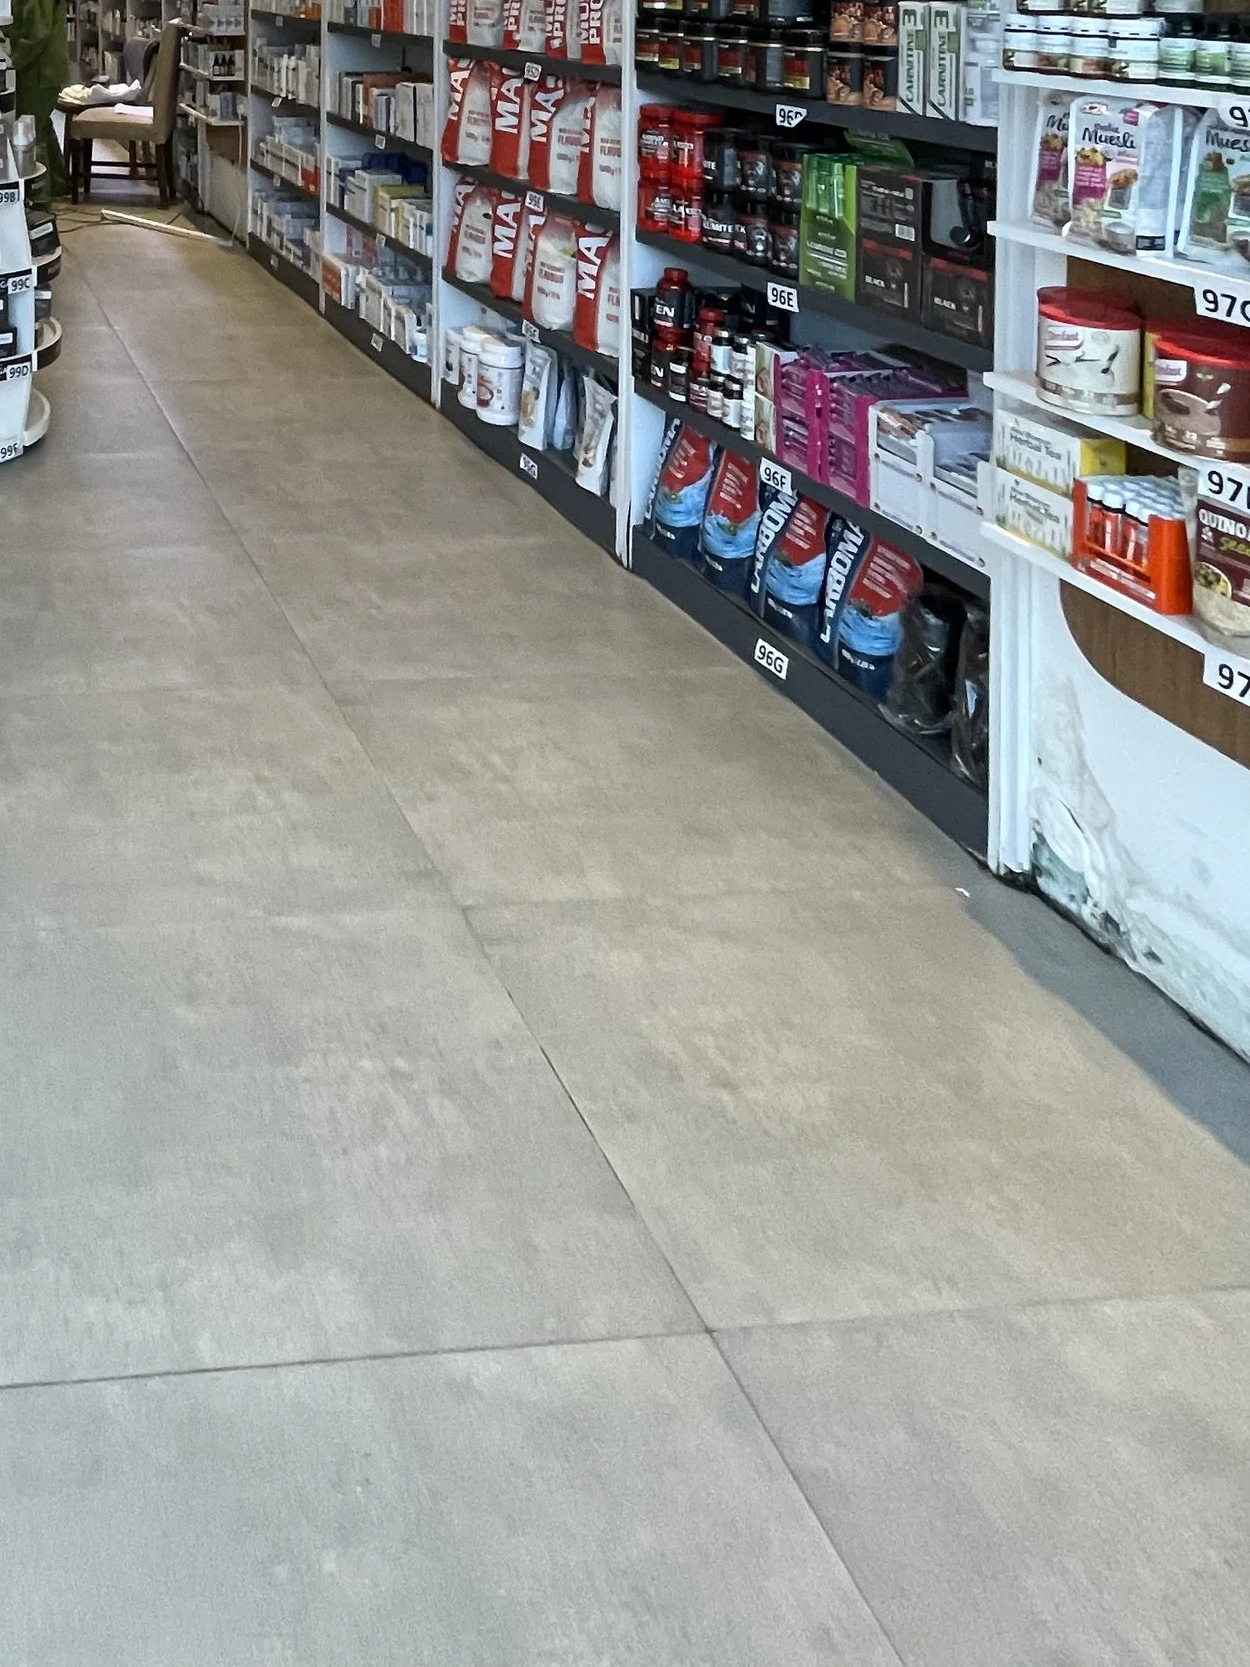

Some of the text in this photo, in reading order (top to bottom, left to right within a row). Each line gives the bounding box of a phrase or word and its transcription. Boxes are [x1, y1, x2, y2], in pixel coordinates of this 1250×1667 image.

[1082, 127, 1136, 149] Muesli
[11, 277, 31, 292] 99C
[771, 287, 794, 308] 96E
[9, 365, 29, 379] 99D
[763, 466, 787, 489] 96F
[1208, 470, 1250, 511] 97
[757, 644, 785, 674] 96G
